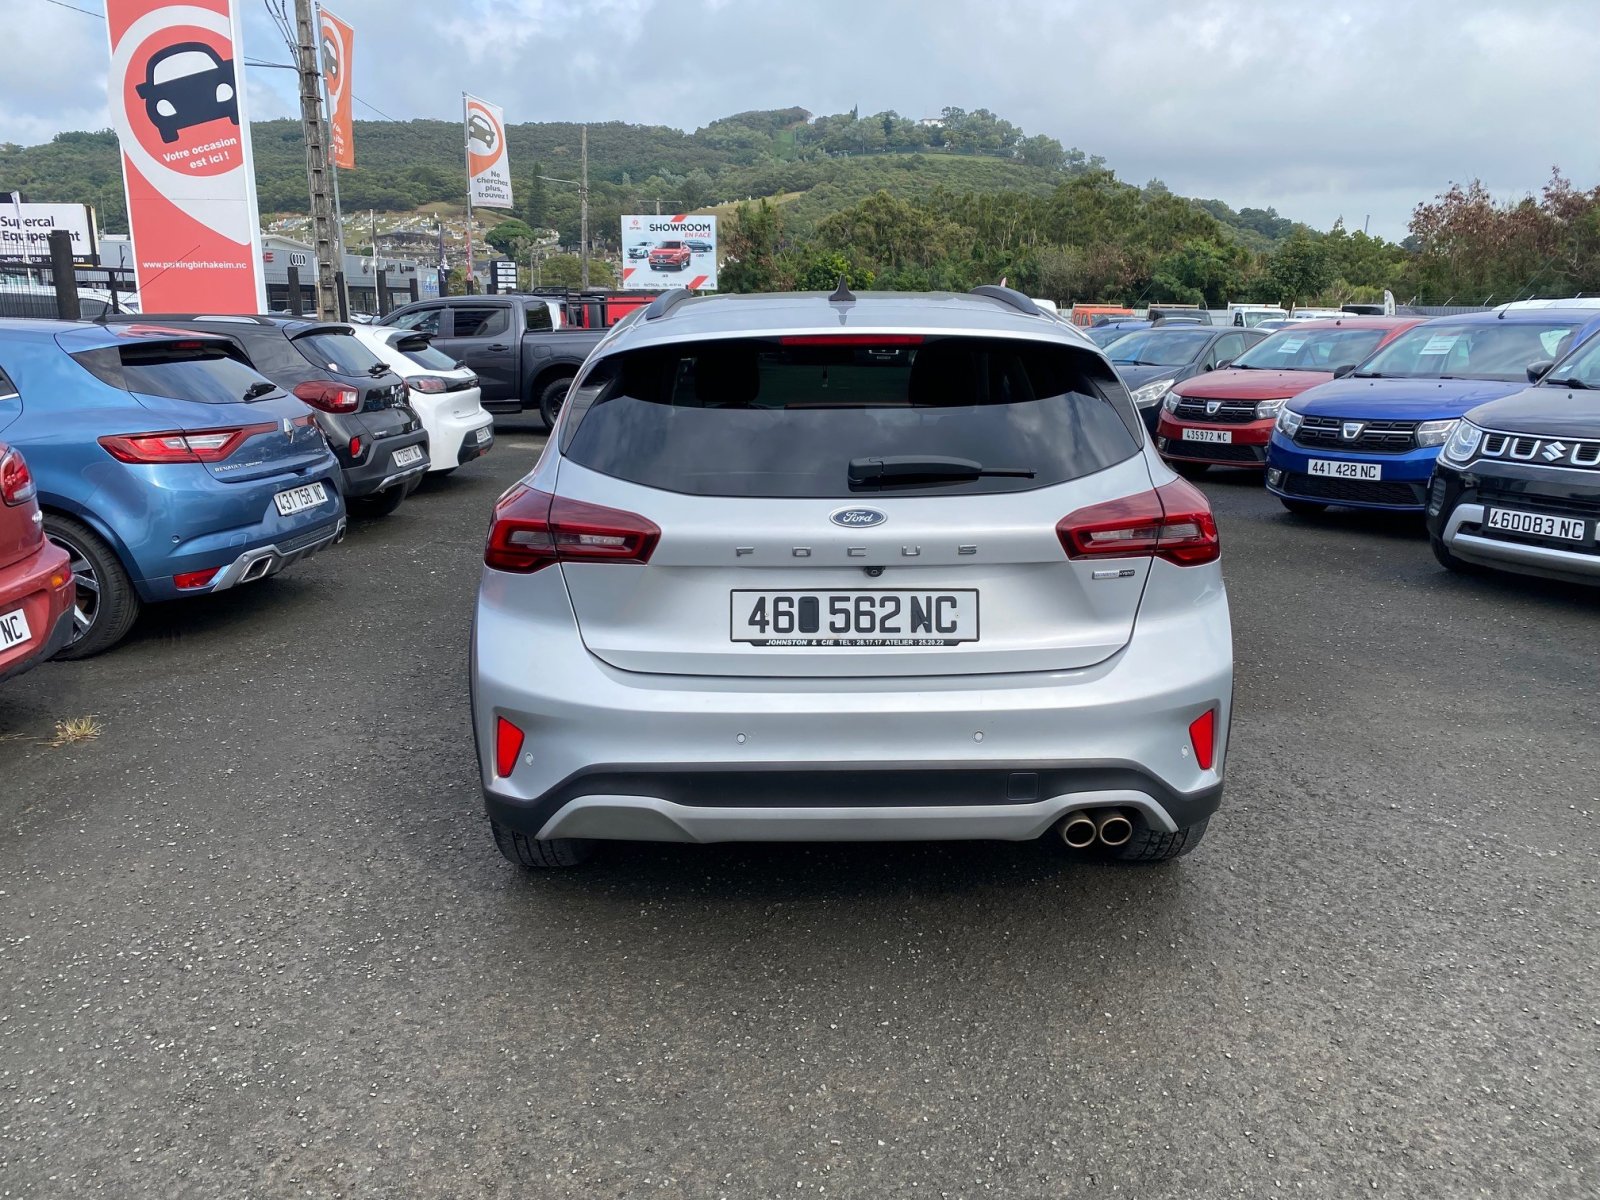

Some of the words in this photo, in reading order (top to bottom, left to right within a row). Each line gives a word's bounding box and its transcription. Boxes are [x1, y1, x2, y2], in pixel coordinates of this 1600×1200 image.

[163, 149, 190, 162] Votre
[192, 137, 237, 154] occasion
[190, 157, 207, 168] est
[209, 152, 223, 163] ici
[477, 177, 508, 186] cherchez
[485, 185, 502, 193] plus,
[649, 224, 711, 232] SHOWROOM
[143, 260, 247, 270] www.parkingbirhakeim.nc
[1186, 430, 1214, 441] 435972
[1217, 432, 1227, 441] NC
[1312, 461, 1331, 475] 441
[1336, 463, 1357, 477] 428
[1360, 466, 1376, 478] NC
[278, 492, 297, 511] 431
[312, 484, 325, 501] NC
[843, 511, 873, 523] Ford
[1490, 511, 1555, 535] 460083
[1560, 520, 1583, 539] NC
[736, 545, 977, 557] FOCUS
[748, 596, 820, 633] 46
[829, 596, 901, 633] 562
[911, 596, 957, 633] NC
[0, 616, 23, 644] NC
